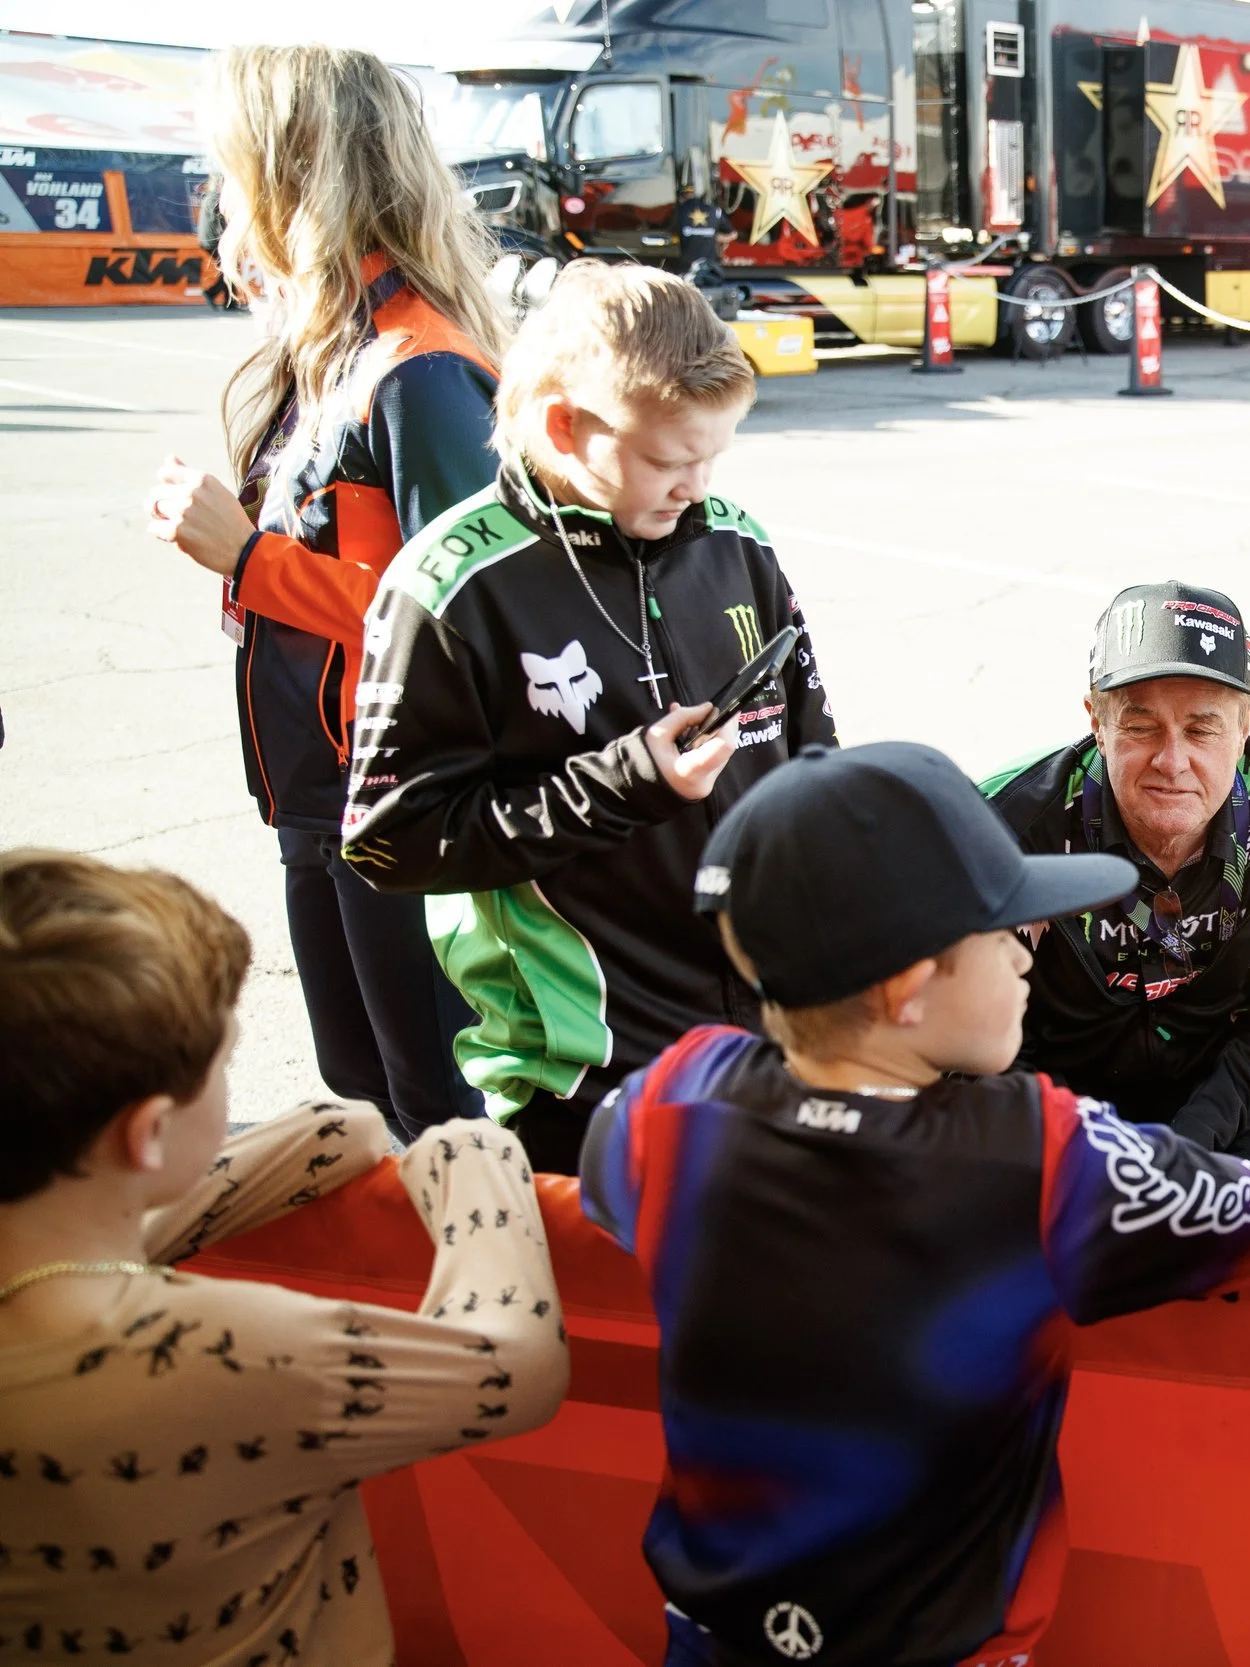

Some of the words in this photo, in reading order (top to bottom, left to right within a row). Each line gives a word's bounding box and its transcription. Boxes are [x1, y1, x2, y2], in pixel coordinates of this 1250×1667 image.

[26, 181, 103, 198] VOHLAND
[54, 198, 100, 229] 34
[85, 248, 203, 286] KTM
[416, 517, 504, 584] FOX
[1160, 601, 1197, 611] PRO
[1174, 614, 1235, 640] Kawasaki
[797, 1097, 862, 1134] KTM
